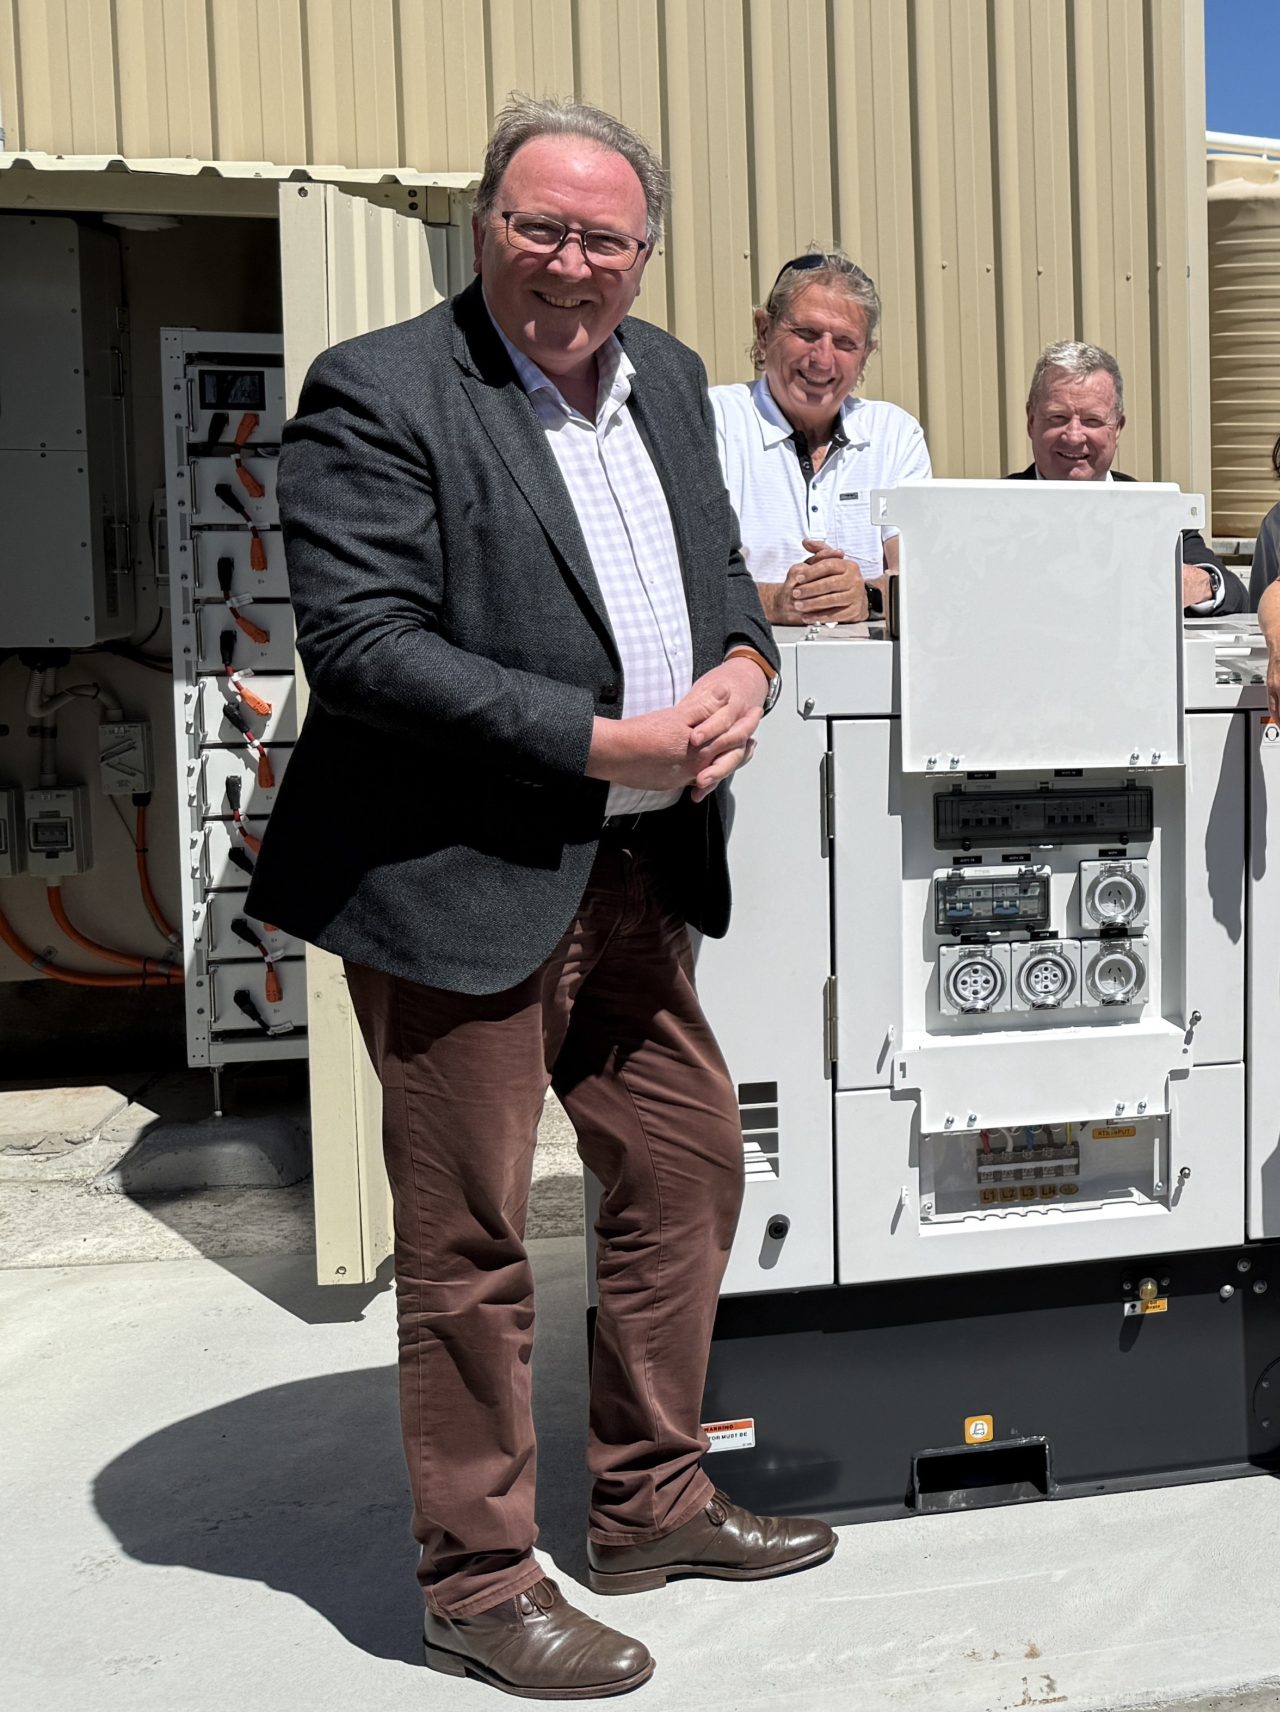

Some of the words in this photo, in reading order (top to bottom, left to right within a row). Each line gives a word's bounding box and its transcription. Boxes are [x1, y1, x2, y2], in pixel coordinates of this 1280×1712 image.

[983, 1190, 995, 1201] L1
[1022, 1187, 1034, 1197] L3
[704, 1424, 734, 1432] WARNING
